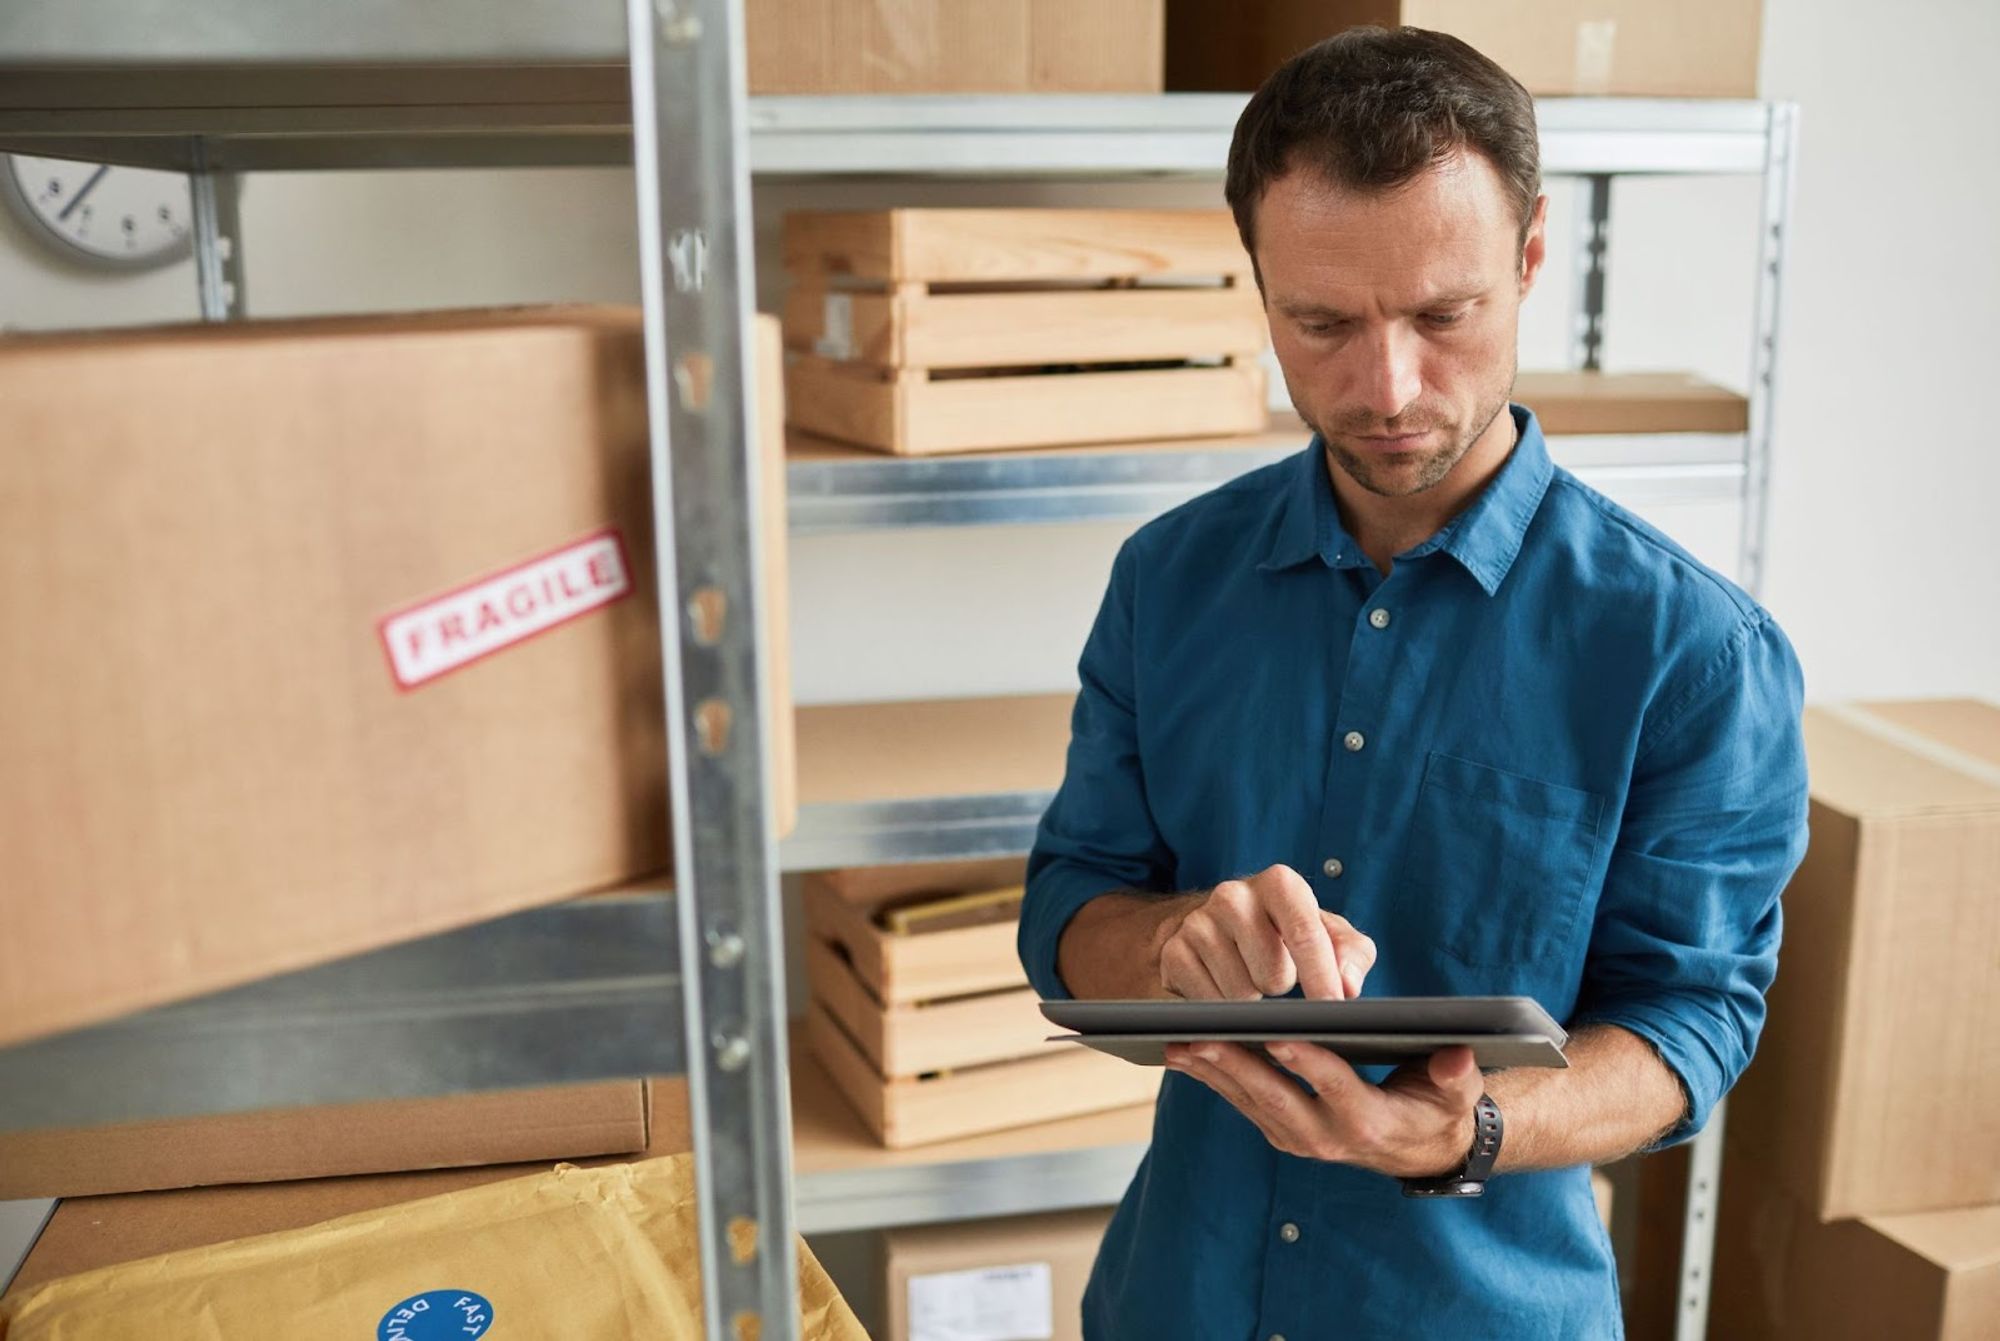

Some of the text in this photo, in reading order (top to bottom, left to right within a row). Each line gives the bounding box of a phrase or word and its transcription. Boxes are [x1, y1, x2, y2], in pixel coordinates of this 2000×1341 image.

[406, 551, 616, 659] FRAGILE
[386, 1299, 430, 1341] DELIV
[453, 1296, 486, 1336] FAST
